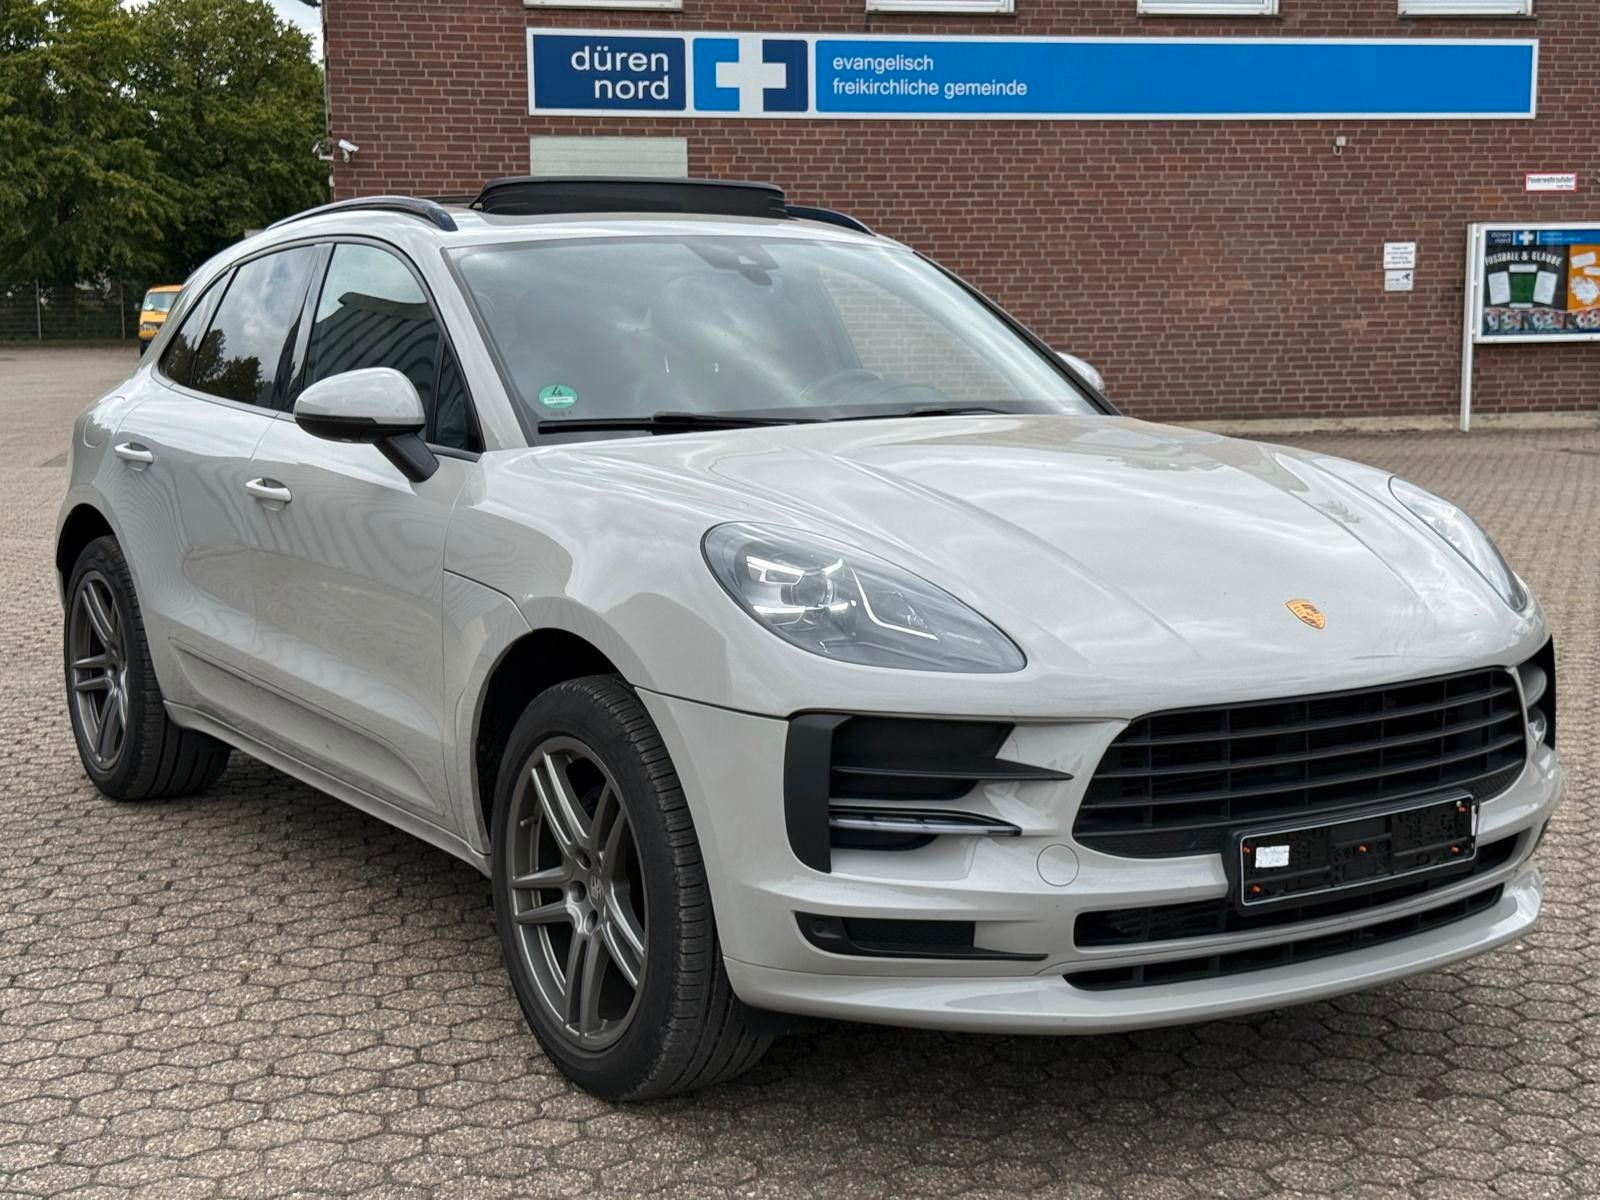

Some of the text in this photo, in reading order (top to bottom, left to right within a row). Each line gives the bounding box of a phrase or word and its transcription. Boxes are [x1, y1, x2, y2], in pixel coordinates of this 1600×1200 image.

[571, 45, 669, 72] düren
[833, 54, 934, 75] evangelisch
[594, 75, 669, 100] nord
[833, 78, 1028, 99] freikirchliche gemeinde
[1521, 251, 1529, 261] &
[552, 385, 562, 397] 4
